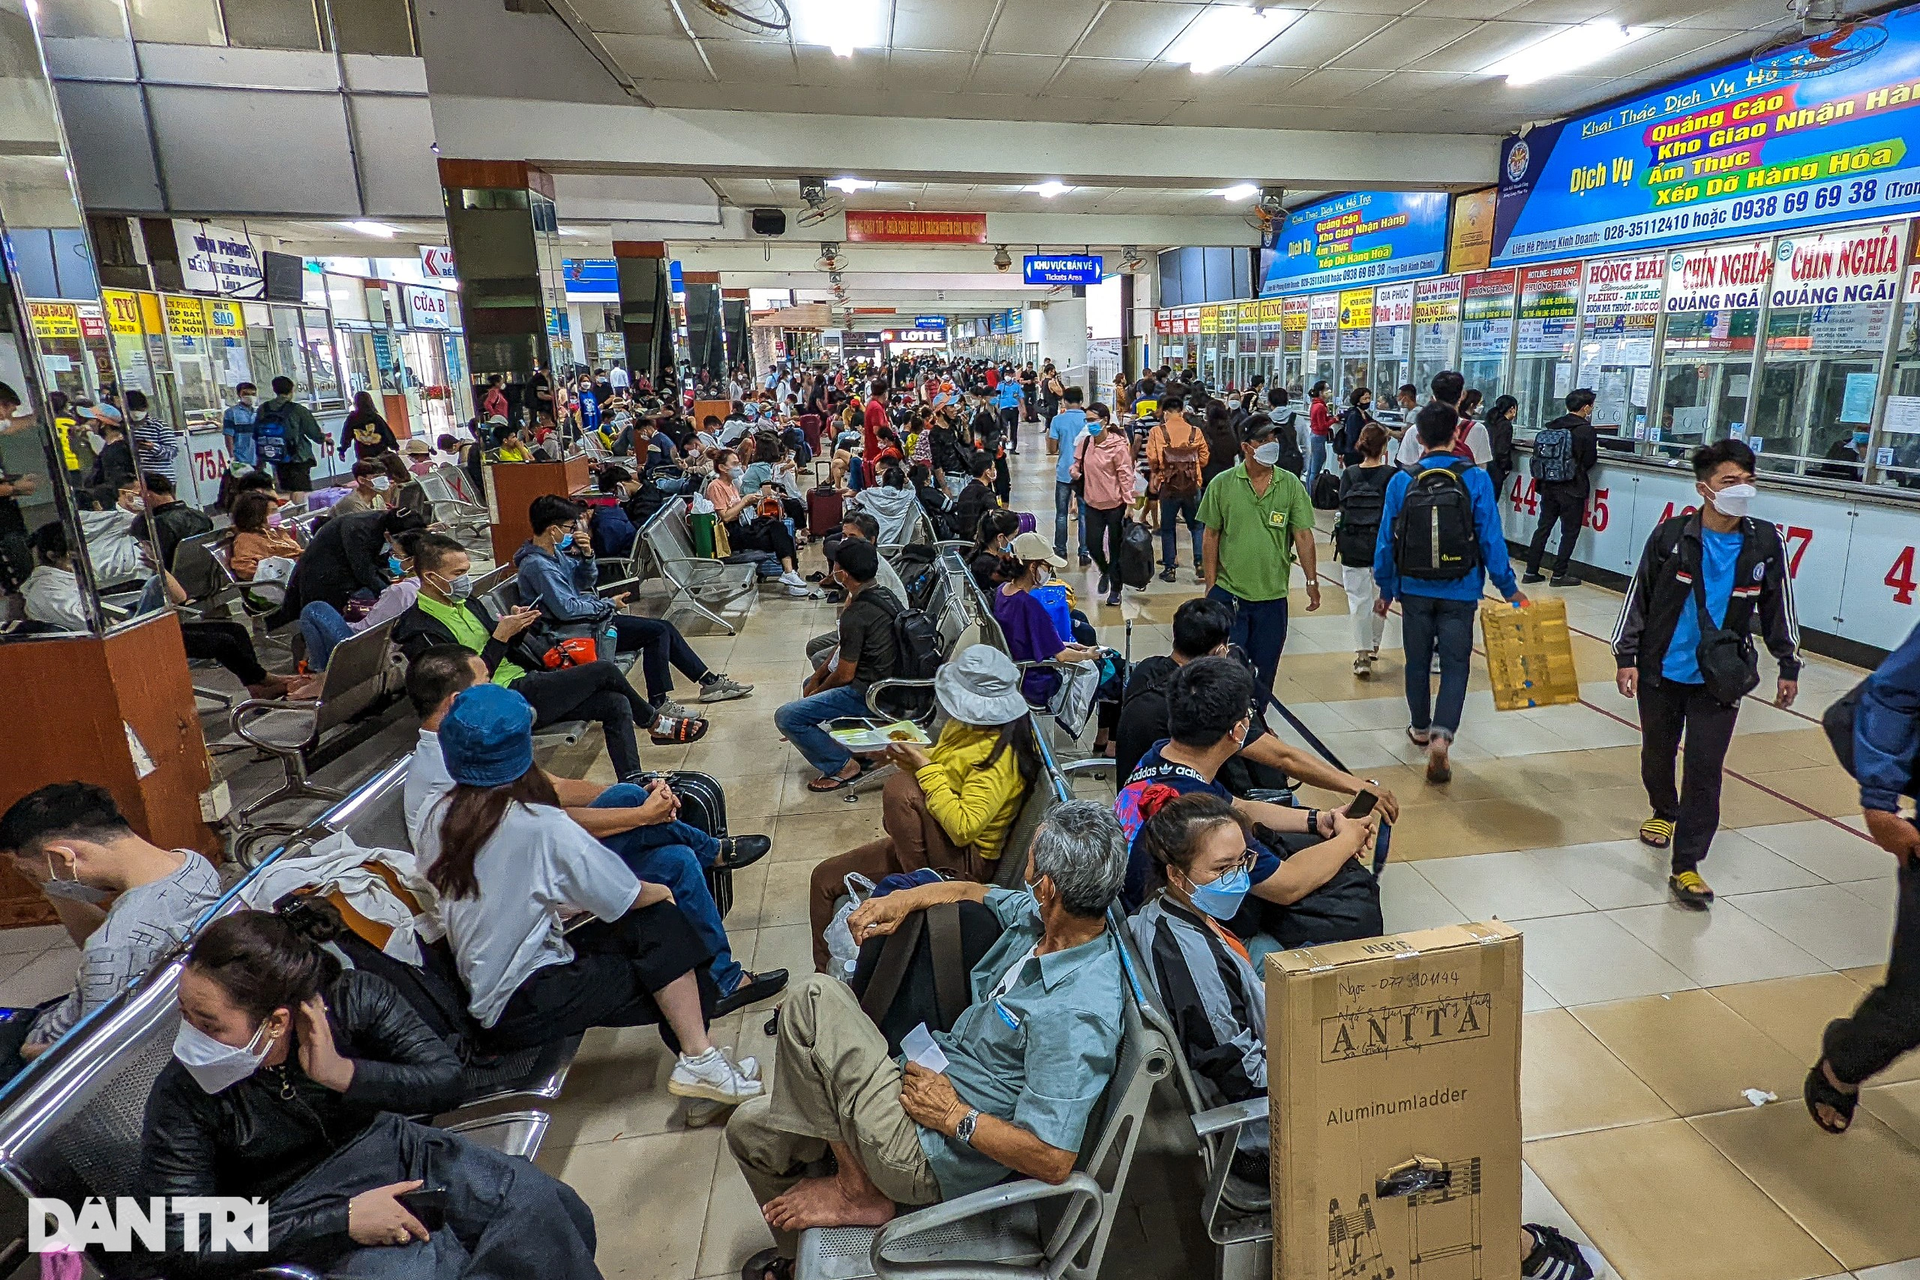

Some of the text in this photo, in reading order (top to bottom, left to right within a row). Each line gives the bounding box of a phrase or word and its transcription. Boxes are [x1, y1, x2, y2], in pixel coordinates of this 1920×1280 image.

[1582, 117, 1613, 137] Khai
[1620, 104, 1657, 125] Thác
[1665, 90, 1701, 113] Dịch
[1710, 78, 1735, 99] Vụ
[1651, 95, 1784, 142] Quảng Cáo
[1658, 138, 1702, 161] Kho
[1709, 122, 1767, 148] Giao
[1775, 100, 1855, 133] Nhận
[1570, 156, 1634, 197] Dịch Vụ
[1648, 151, 1751, 185] Ẩm Thực
[1656, 147, 1893, 207] Xếp Dỡ Hàng Hóa
[1316, 213, 1359, 232] Quảng Cáo
[1574, 231, 1601, 246] Doanh:
[1604, 213, 1688, 242] 028-35112410
[1693, 207, 1727, 230] hoặc
[1731, 196, 1777, 222] 0938
[1783, 191, 1809, 215] 69
[1815, 185, 1842, 210] 69
[1849, 179, 1878, 204] 38
[1318, 213, 1406, 244] Kho Giao Nhận Hàng
[217, 237, 252, 259] PHÒNG
[1288, 238, 1312, 259] Dịch Vụ
[1318, 256, 1334, 269] Xếp
[1348, 250, 1369, 265] Hàng
[1371, 247, 1389, 261] Hóa
[1330, 243, 1349, 255] Thực
[1791, 224, 1899, 282] CHÍN NGHĨA
[1034, 260, 1093, 272] KHU VỰC BÁN VÉ
[1343, 268, 1357, 281] 0938
[1358, 267, 1367, 279] 69
[1367, 265, 1376, 278] 69
[1376, 263, 1386, 276] 38
[1589, 254, 1665, 284] HỒNG HẢI
[1683, 241, 1769, 290] CHÍN NGHĨA
[1380, 291, 1391, 301] GIA
[1391, 286, 1409, 300] PHÚC
[1417, 281, 1438, 296] XUÂN
[1491, 283, 1513, 295] TRANG
[1524, 278, 1578, 293] PHƯƠNG TRANG
[1772, 279, 1896, 307] QUẢNG NGÃI
[413, 291, 445, 313] CỬA B
[1585, 303, 1601, 313] BUÔN
[1601, 304, 1611, 313] MA
[1587, 292, 1619, 303] PLEIKU
[1624, 291, 1639, 301] AN
[1667, 287, 1759, 312] QUẢNG NGÃ
[212, 310, 235, 327] SAO
[1415, 304, 1440, 318] HOÀNG
[1434, 314, 1458, 322] NHƠN
[1812, 305, 1832, 323] 47
[901, 331, 942, 342] LOTTE
[1510, 475, 1538, 516] 44
[1776, 524, 1813, 579] 7
[1132, 766, 1157, 781] adidas
[1330, 1003, 1481, 1054] ANITA
[1326, 1087, 1469, 1126] Aluminumladder
